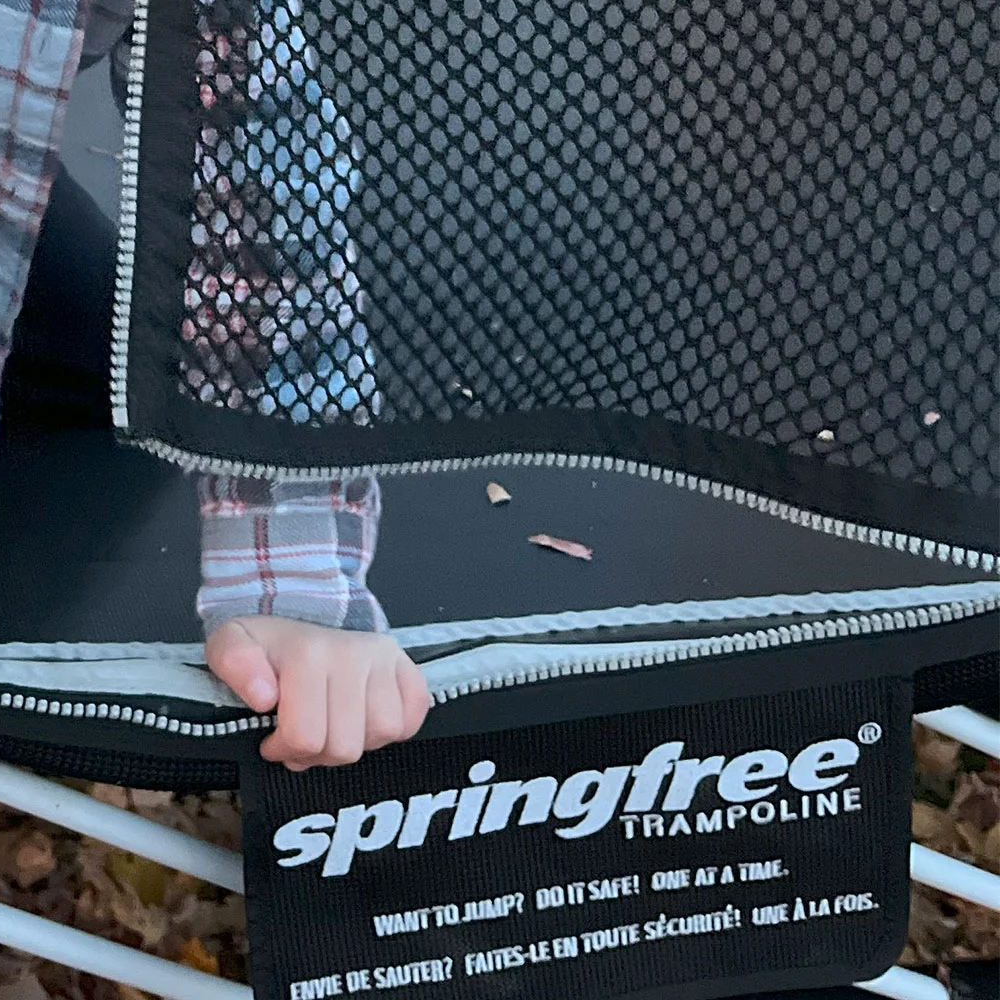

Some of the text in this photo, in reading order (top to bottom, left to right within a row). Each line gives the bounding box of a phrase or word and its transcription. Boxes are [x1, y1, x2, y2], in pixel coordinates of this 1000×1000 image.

[273, 741, 860, 877] springfree
[620, 787, 862, 840] TRAMPOLINE
[374, 859, 789, 937] WANT TO JUMP? DO IT SAFE! ONE AT A TIME.
[291, 892, 879, 1000] ENVIE DE SAUTER? FAITES-LE EN TOUTE SÉCURITÉ! UNE À LA FOIS.
